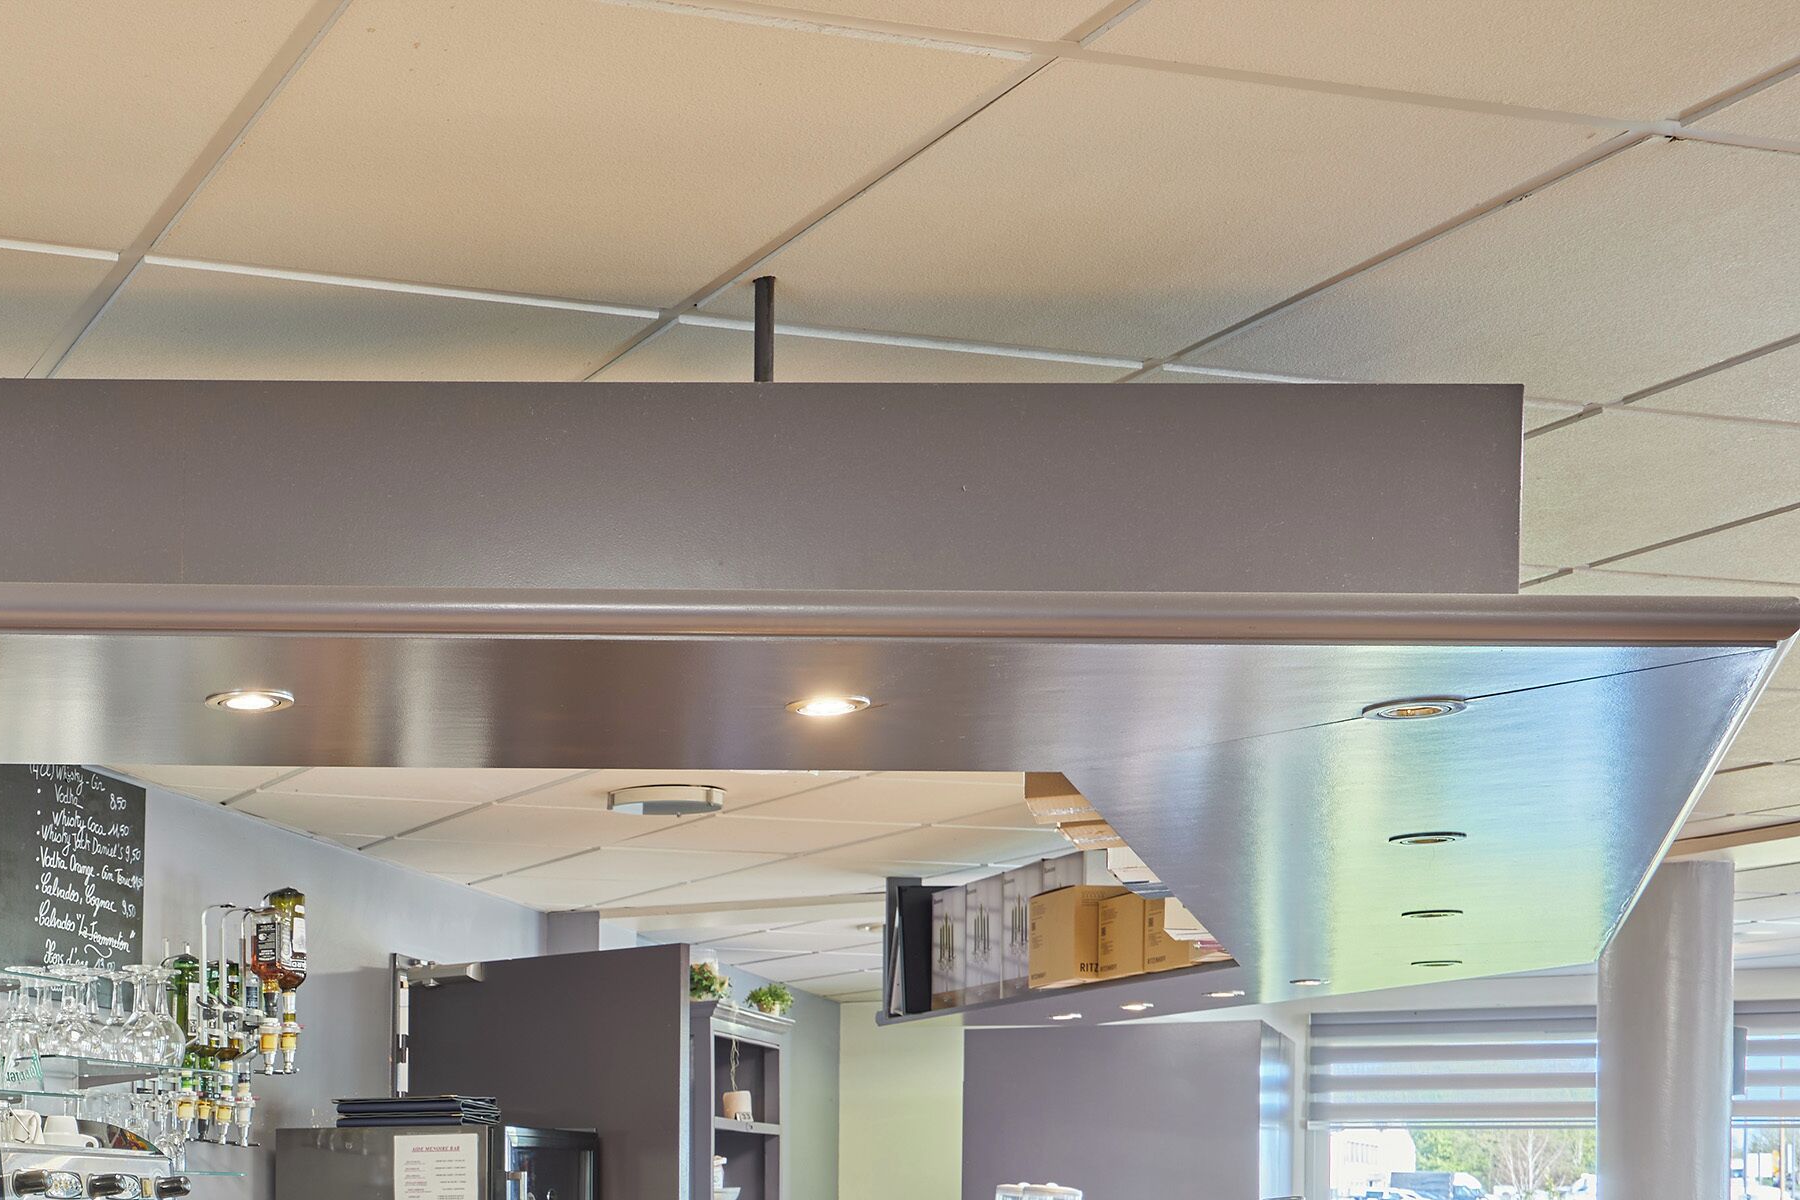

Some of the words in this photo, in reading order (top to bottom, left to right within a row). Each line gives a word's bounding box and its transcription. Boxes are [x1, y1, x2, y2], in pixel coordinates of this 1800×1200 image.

[54, 783, 84, 809] Vodka
[87, 816, 107, 836] Coca
[40, 846, 68, 870] Vodka
[85, 883, 118, 918] Cognac
[38, 899, 76, 932] Calvados
